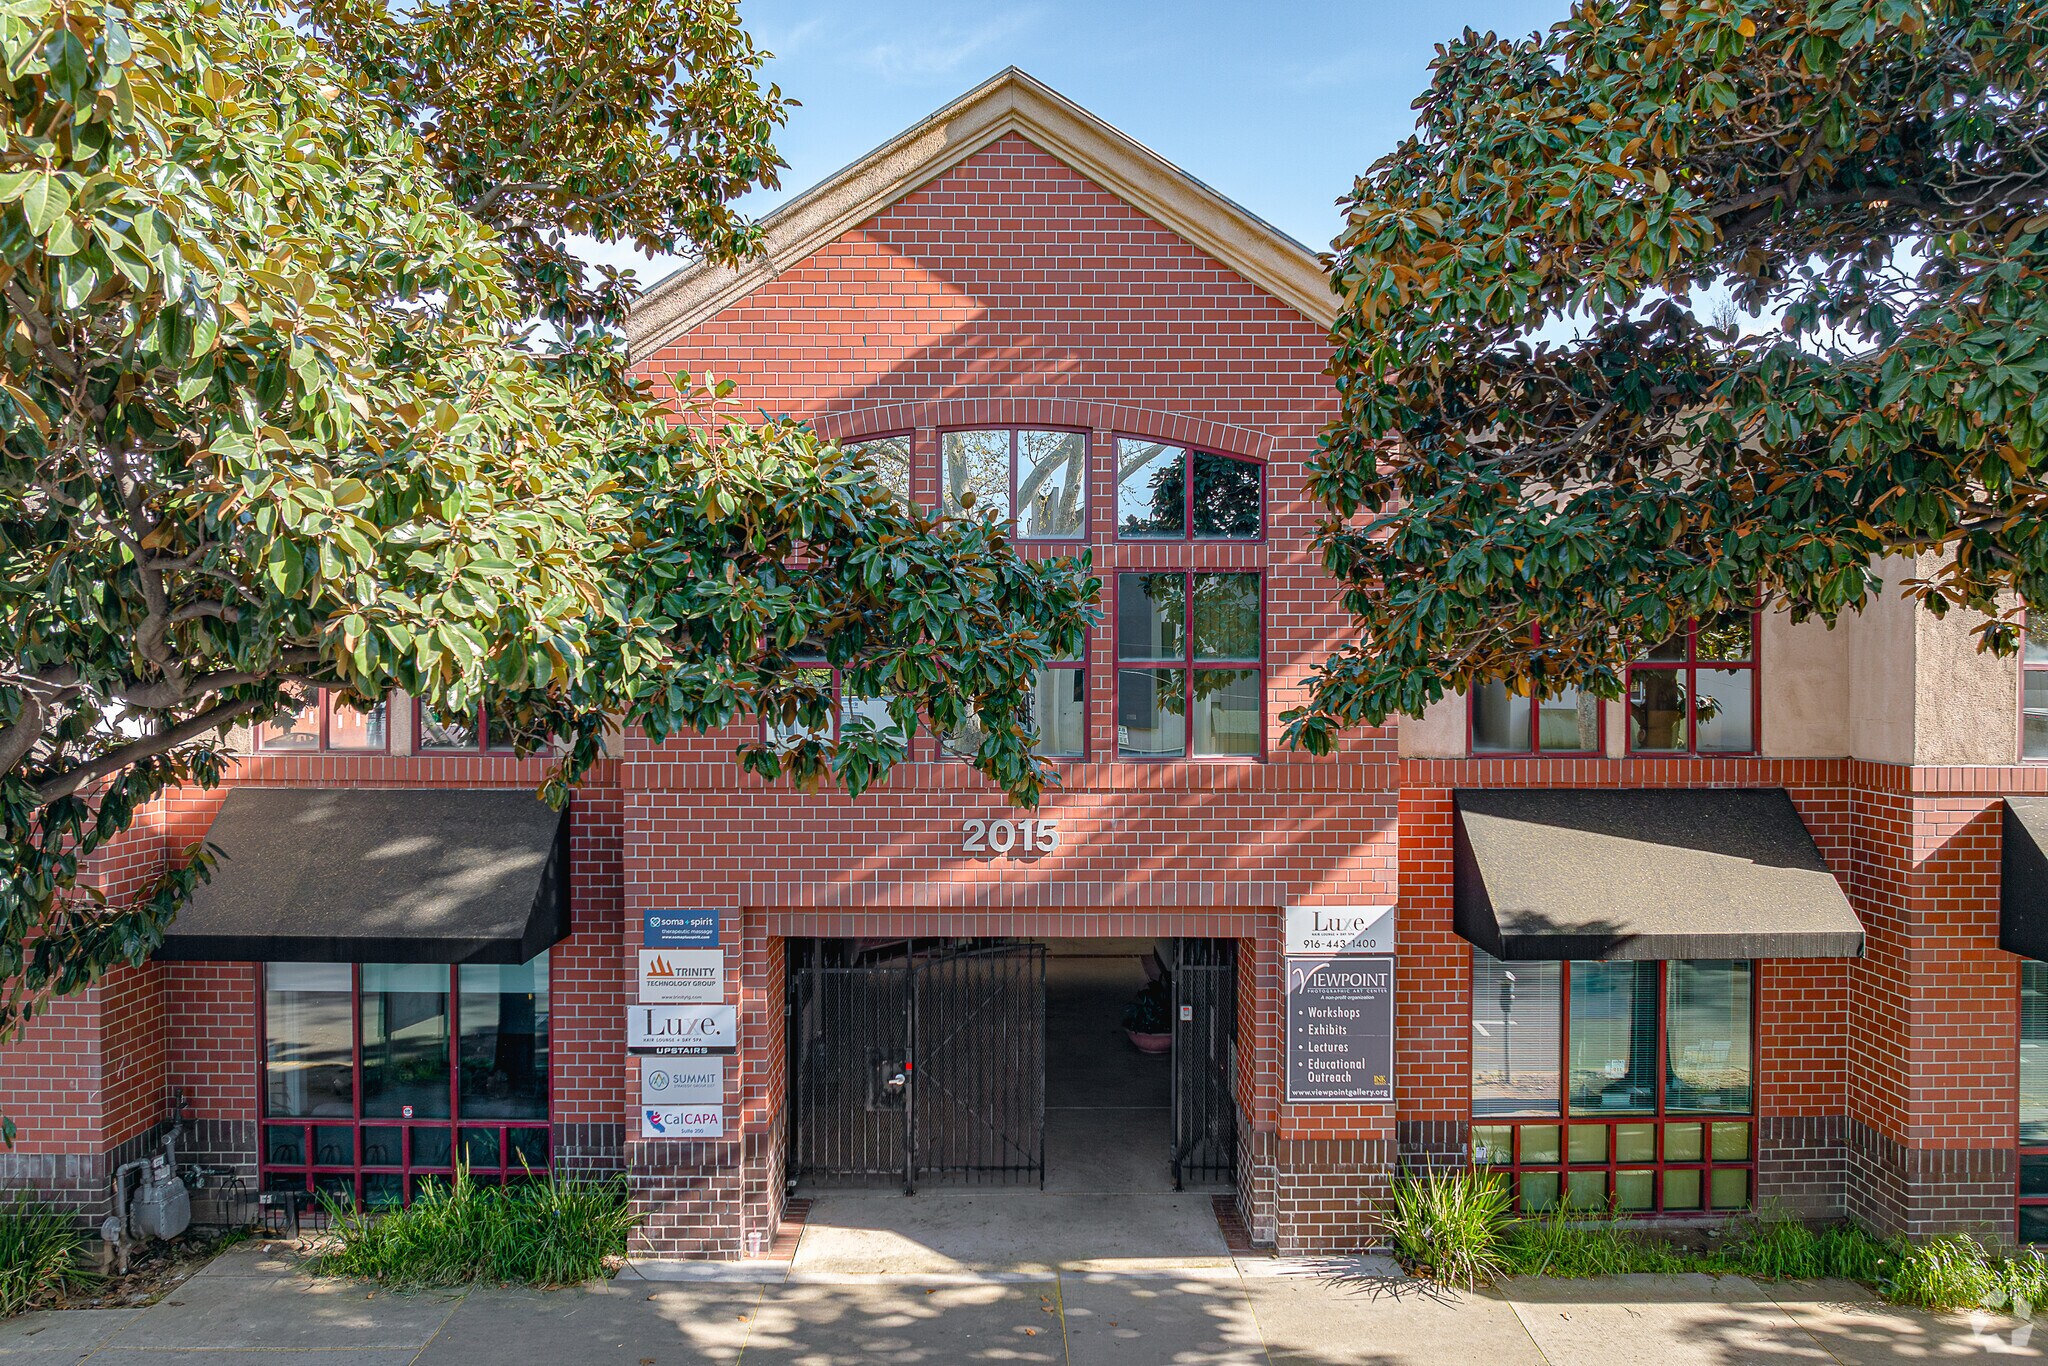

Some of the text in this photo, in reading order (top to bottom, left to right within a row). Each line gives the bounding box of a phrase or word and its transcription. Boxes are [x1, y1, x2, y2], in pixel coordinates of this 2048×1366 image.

[962, 819, 1060, 852] 2015
[661, 918, 684, 926] soma
[690, 917, 713, 928] spirit
[1312, 911, 1368, 931] Luxe.
[1303, 939, 1376, 949] 916-443-1400
[675, 968, 715, 976] TRINITY
[1292, 962, 1388, 994] VIEWPOINT
[1308, 1006, 1360, 1020] Workshops
[643, 1009, 720, 1036] Luxe.
[1308, 1024, 1347, 1035] Exhibits
[1308, 1041, 1349, 1053] Lectures
[1308, 1058, 1366, 1070] Educational
[673, 1074, 716, 1083] SUMMIT
[1308, 1071, 1352, 1083] Outreach
[1292, 1088, 1388, 1097] www.viewpointgallery.org
[664, 1113, 718, 1124] CalCAPA
